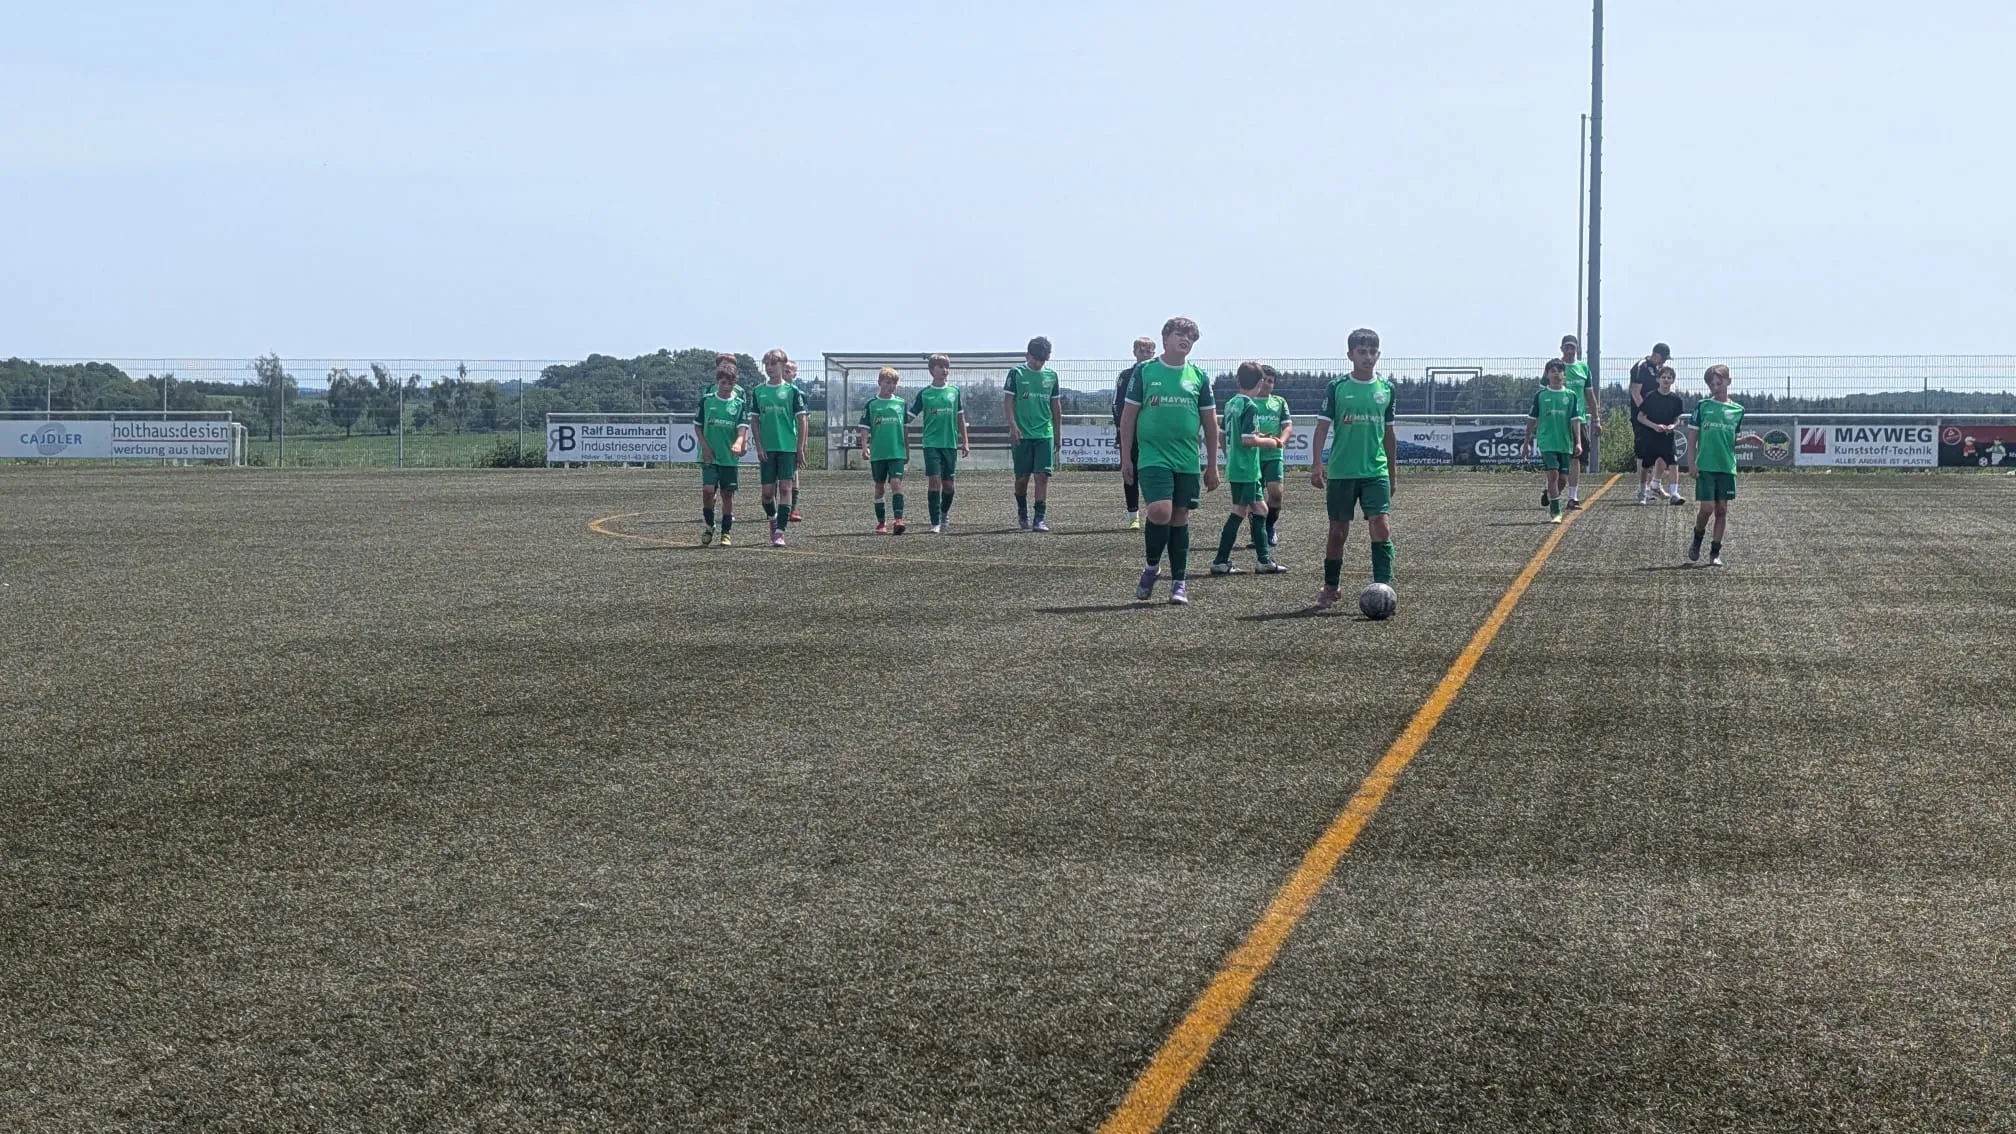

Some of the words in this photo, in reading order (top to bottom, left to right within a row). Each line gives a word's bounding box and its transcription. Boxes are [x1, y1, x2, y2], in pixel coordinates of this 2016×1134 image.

[112, 422, 229, 438] holthaus:design
[581, 426, 604, 436] Ralf
[606, 426, 667, 436] Baumhardt
[1834, 428, 1933, 443] MAYWEG
[114, 444, 165, 456] werbung
[168, 446, 188, 455] aus
[191, 444, 228, 455] halver
[581, 440, 667, 452] Industrieservice
[1834, 445, 1933, 455] Kunststoff-Technik
